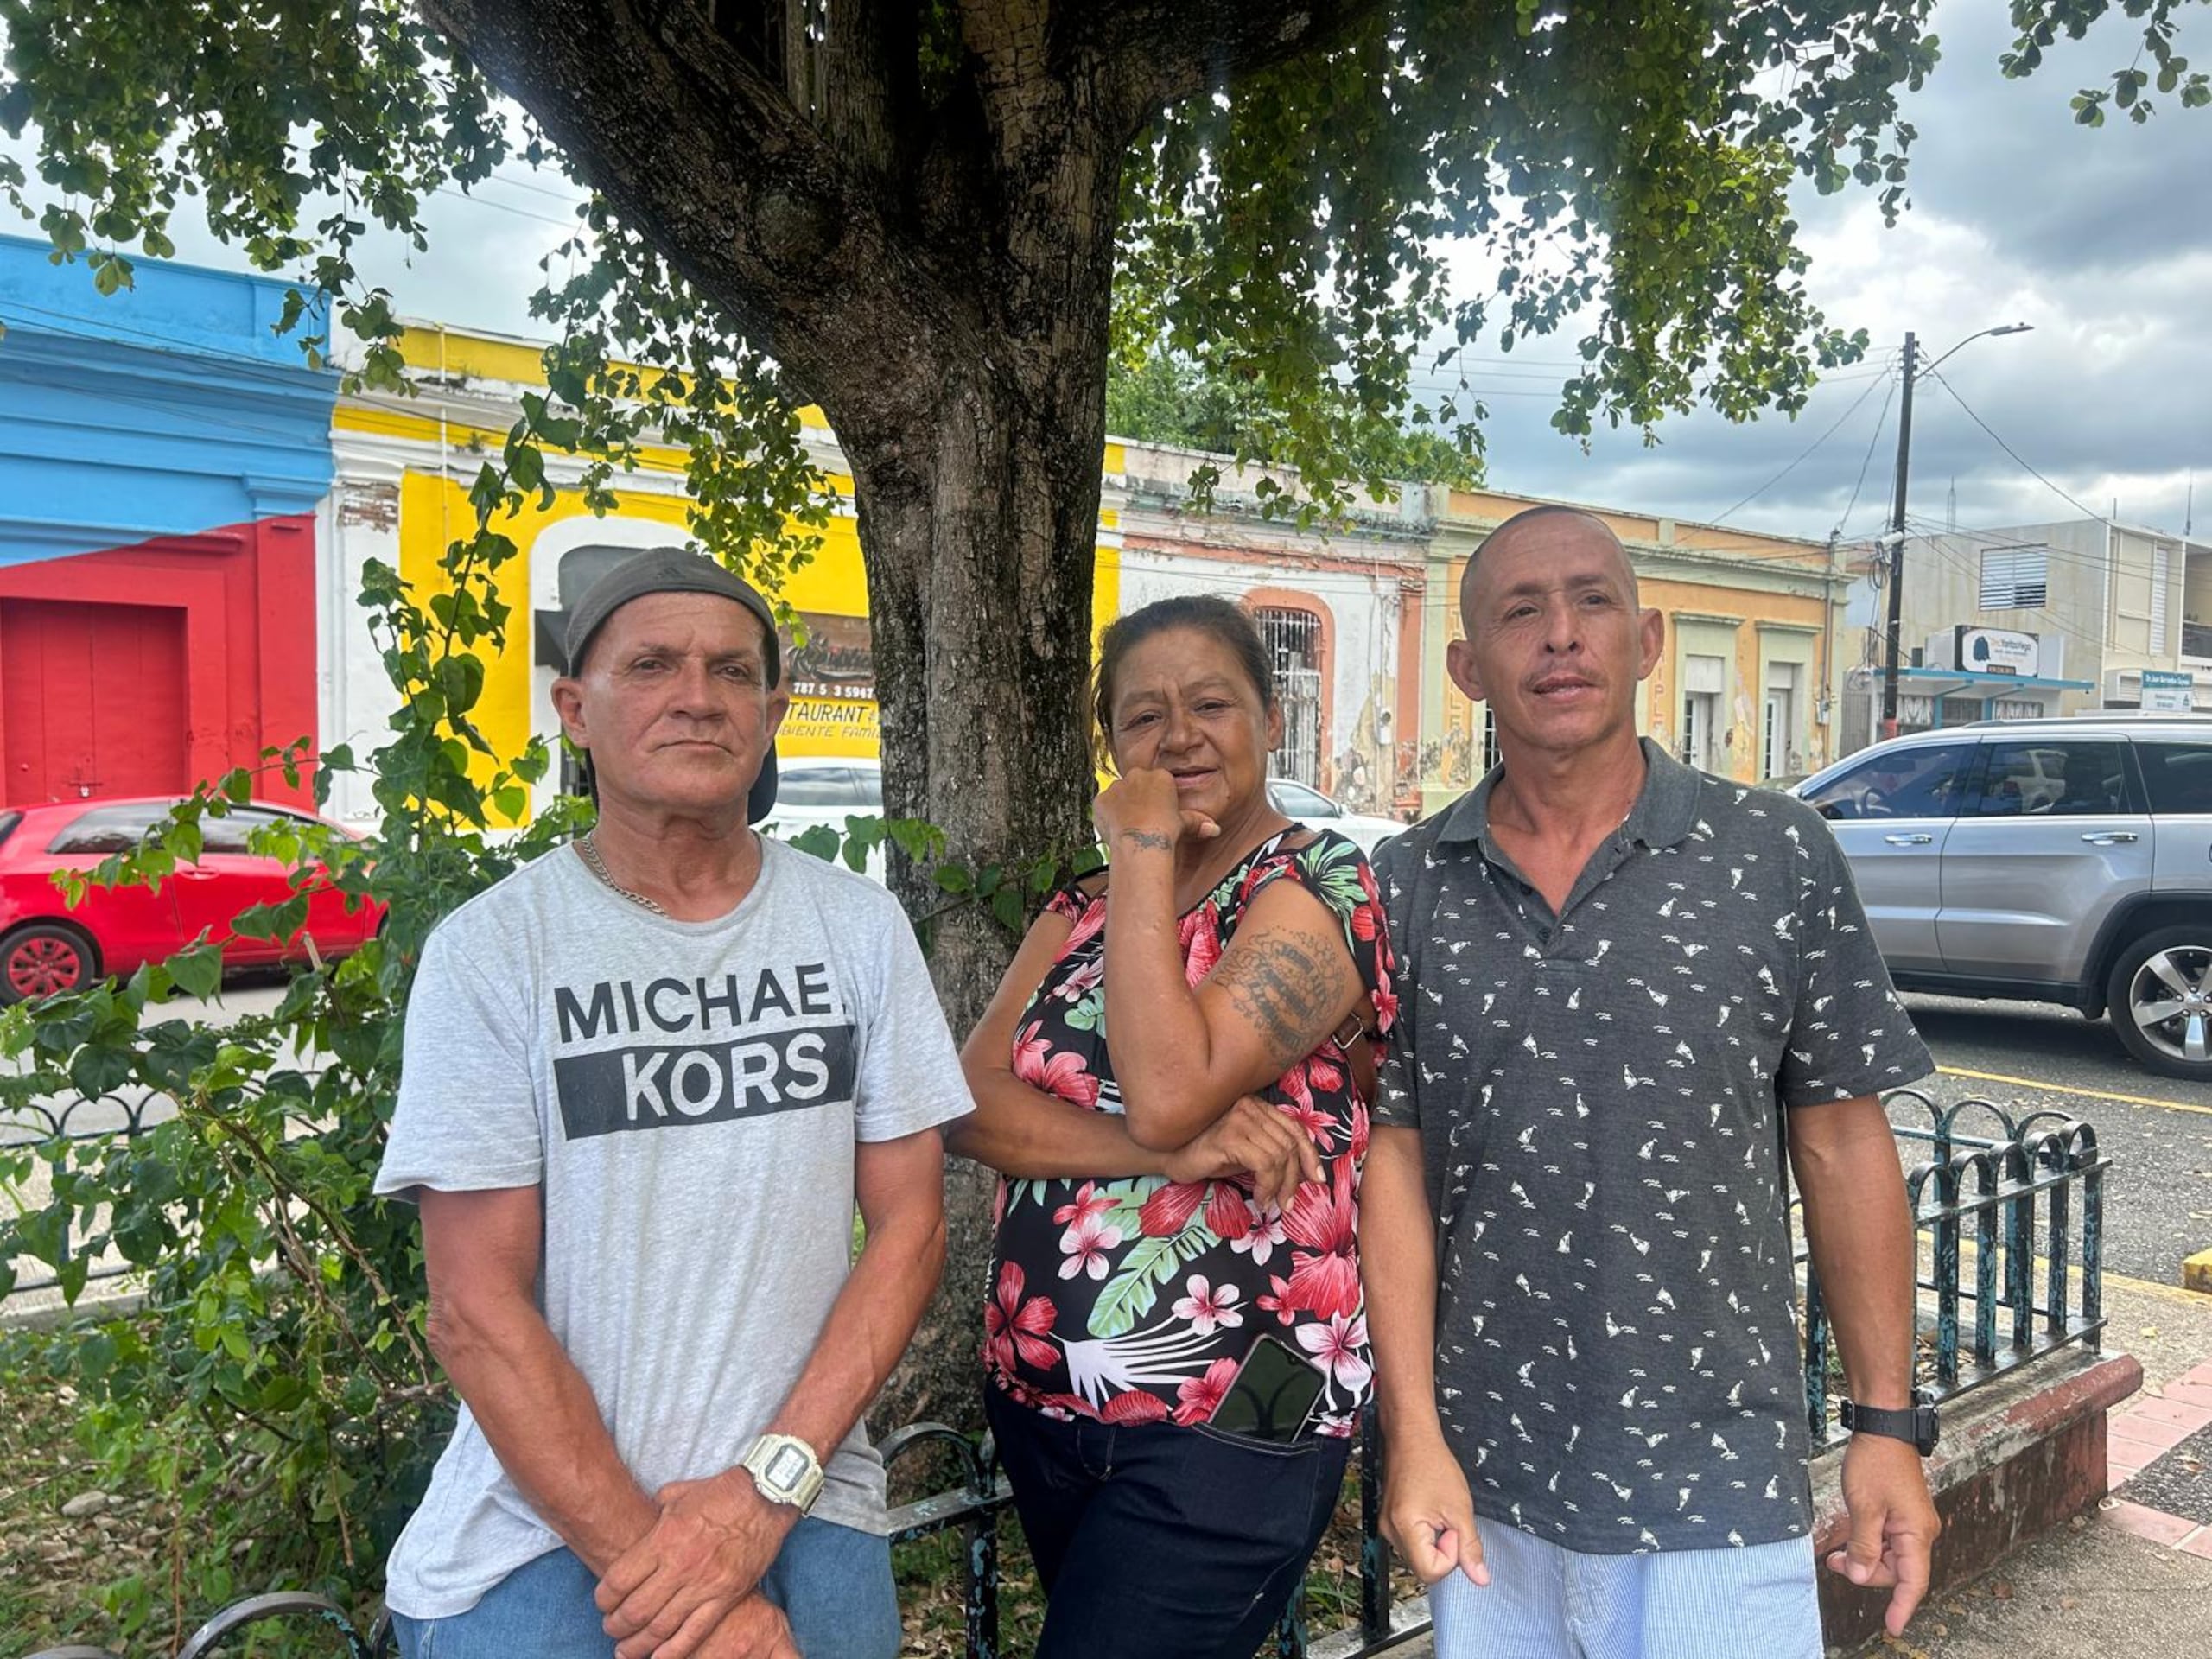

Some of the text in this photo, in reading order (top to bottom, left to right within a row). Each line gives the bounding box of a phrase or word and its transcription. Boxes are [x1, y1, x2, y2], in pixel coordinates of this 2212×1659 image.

[794, 683, 815, 694] 787
[819, 684, 827, 696] 5
[554, 963, 846, 1043] MICHAE
[622, 1033, 829, 1121] KORS
